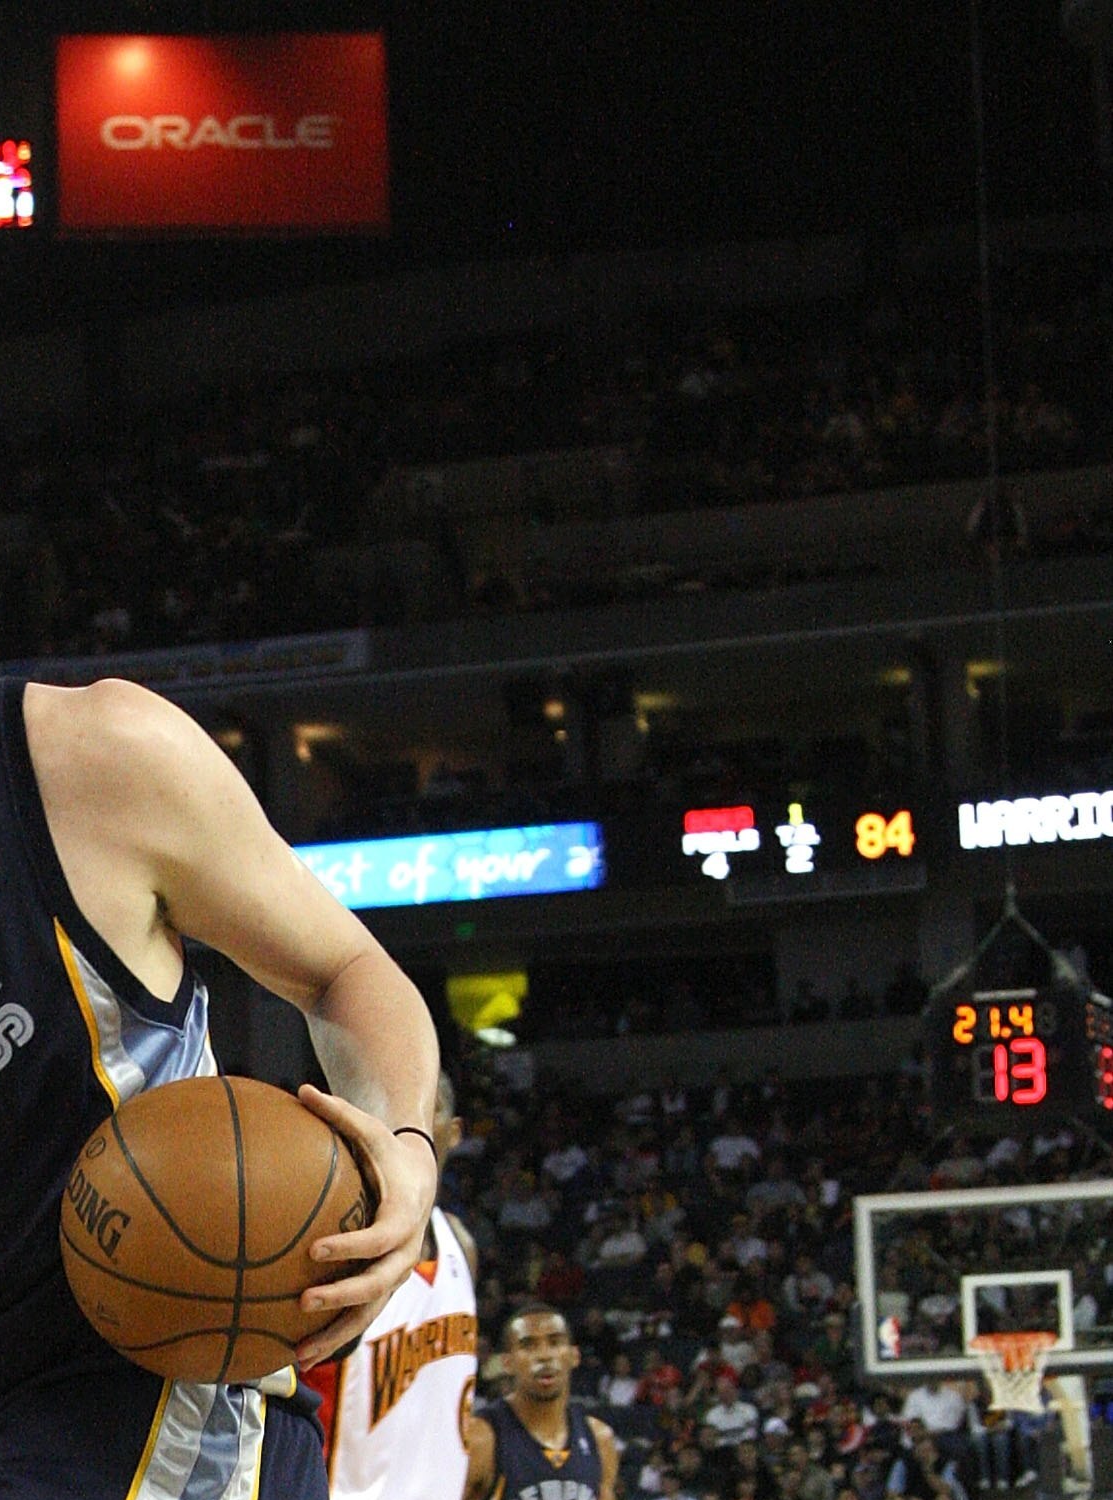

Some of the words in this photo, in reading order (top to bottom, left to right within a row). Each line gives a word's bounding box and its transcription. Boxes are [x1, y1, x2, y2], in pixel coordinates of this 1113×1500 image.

[99, 114, 338, 151] ORACLE
[855, 809, 915, 859] 84
[388, 842, 437, 905] of
[454, 847, 551, 900] your
[993, 1037, 1047, 1104] 13
